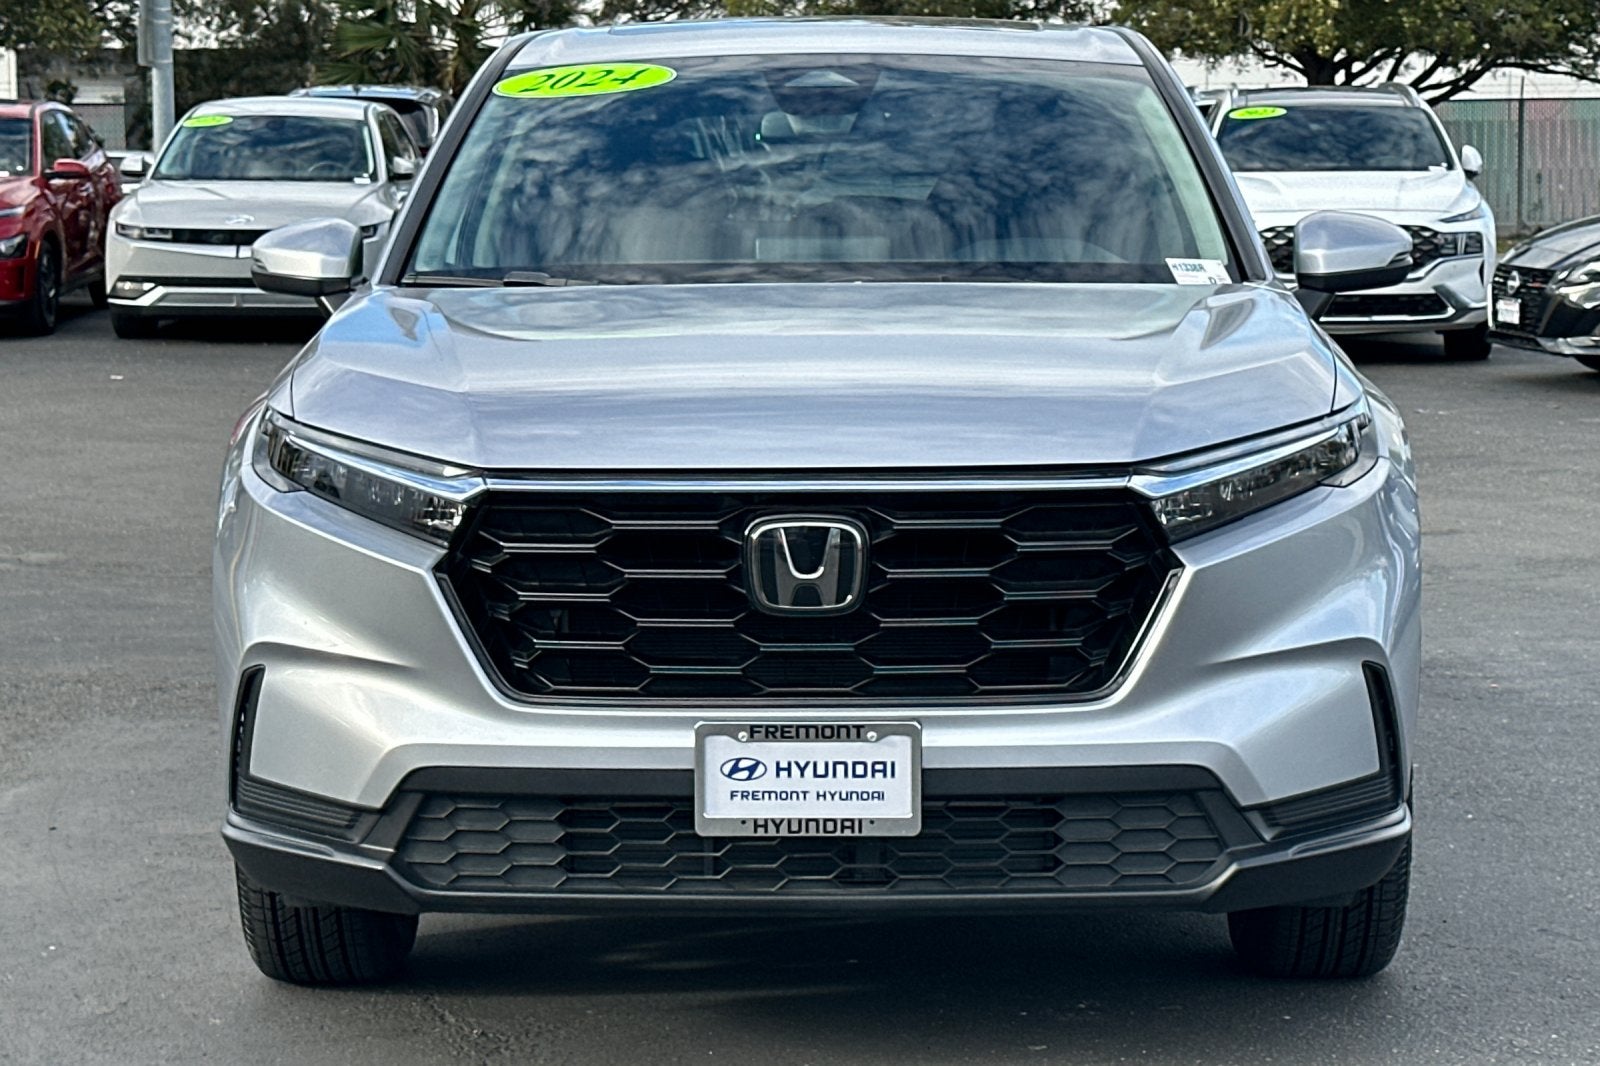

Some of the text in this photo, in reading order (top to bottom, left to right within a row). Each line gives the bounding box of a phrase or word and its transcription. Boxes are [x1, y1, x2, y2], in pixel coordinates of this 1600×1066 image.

[517, 67, 651, 93] 2024
[749, 724, 866, 740] FREMONT
[775, 760, 896, 779] HYUNDAI
[729, 789, 886, 802] FREMONT HYUNDAI
[752, 817, 864, 835] HYUNDAI
